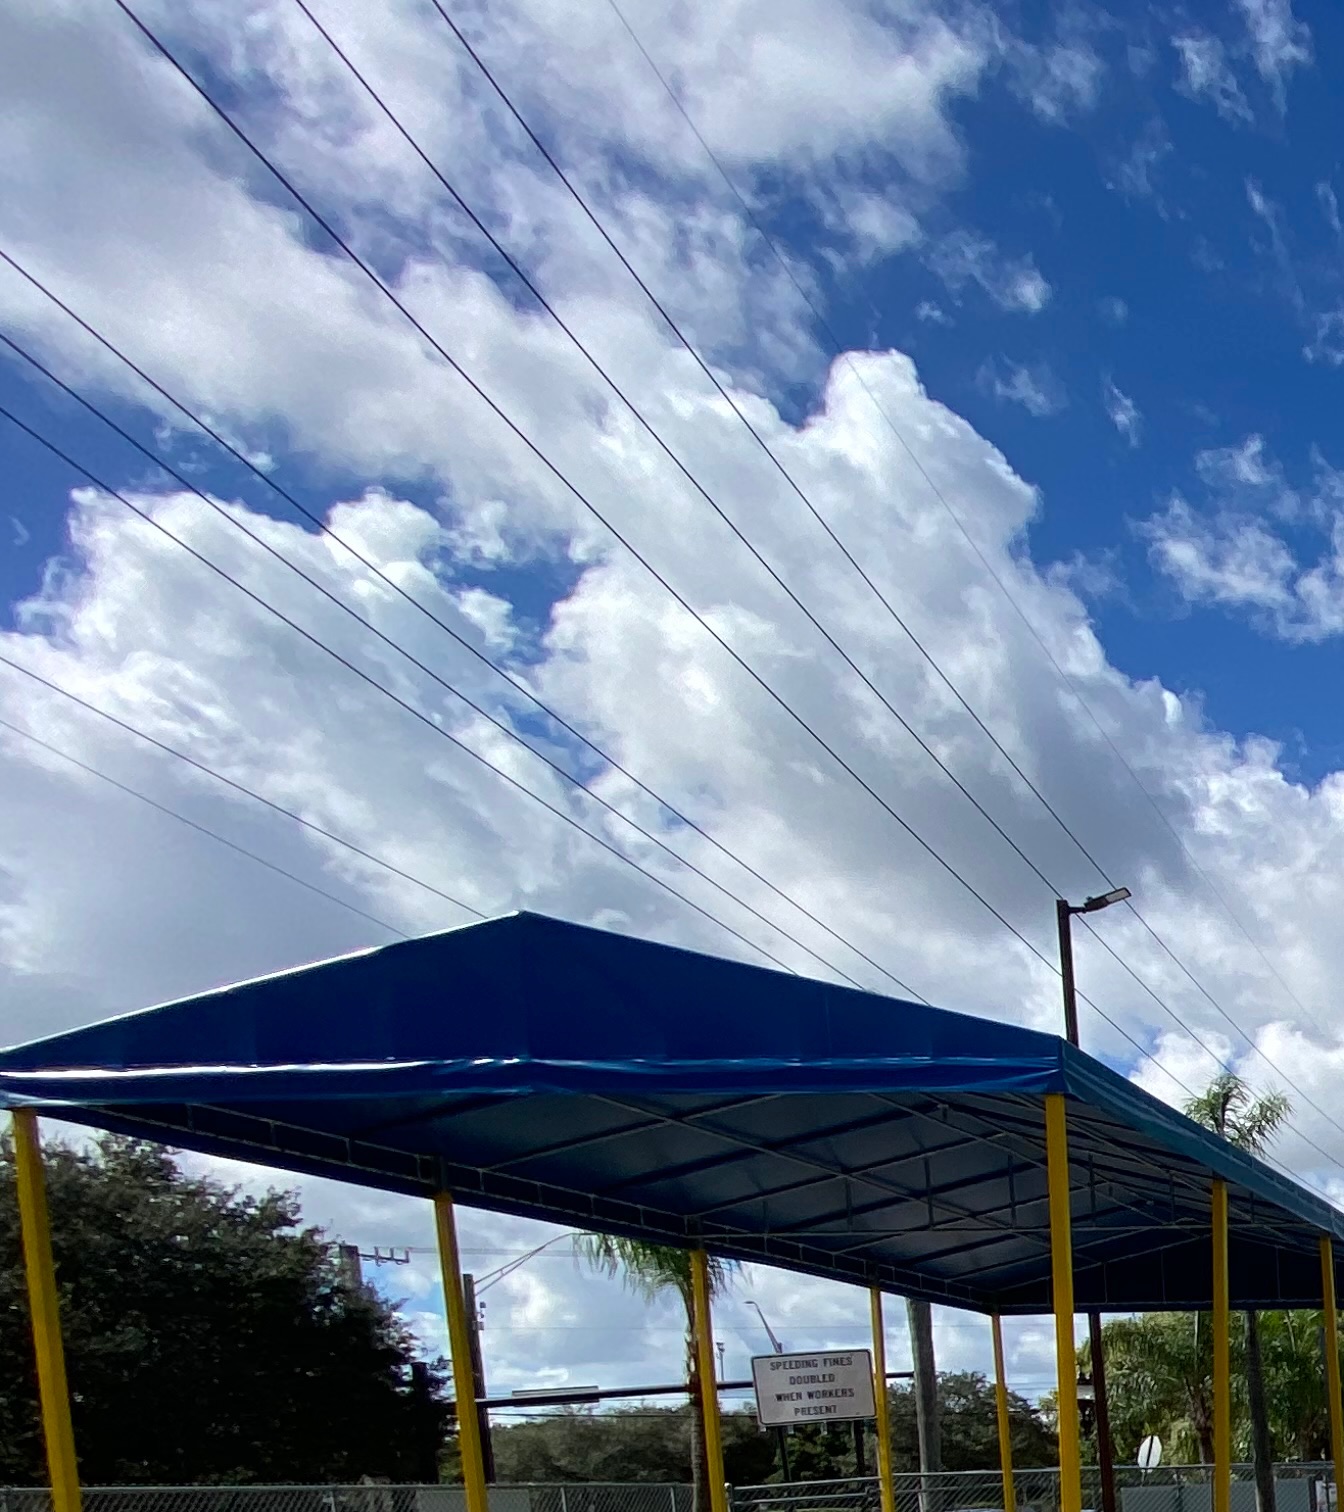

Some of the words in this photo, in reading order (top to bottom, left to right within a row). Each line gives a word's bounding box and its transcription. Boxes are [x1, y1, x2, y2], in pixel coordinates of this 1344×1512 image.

[769, 1359, 818, 1371] SPEEDING
[823, 1356, 853, 1367] FINES
[789, 1373, 836, 1385] DOUBLED
[775, 1391, 803, 1402] WHEN
[807, 1388, 855, 1400] WORKERS
[794, 1405, 838, 1416] PRESENT
